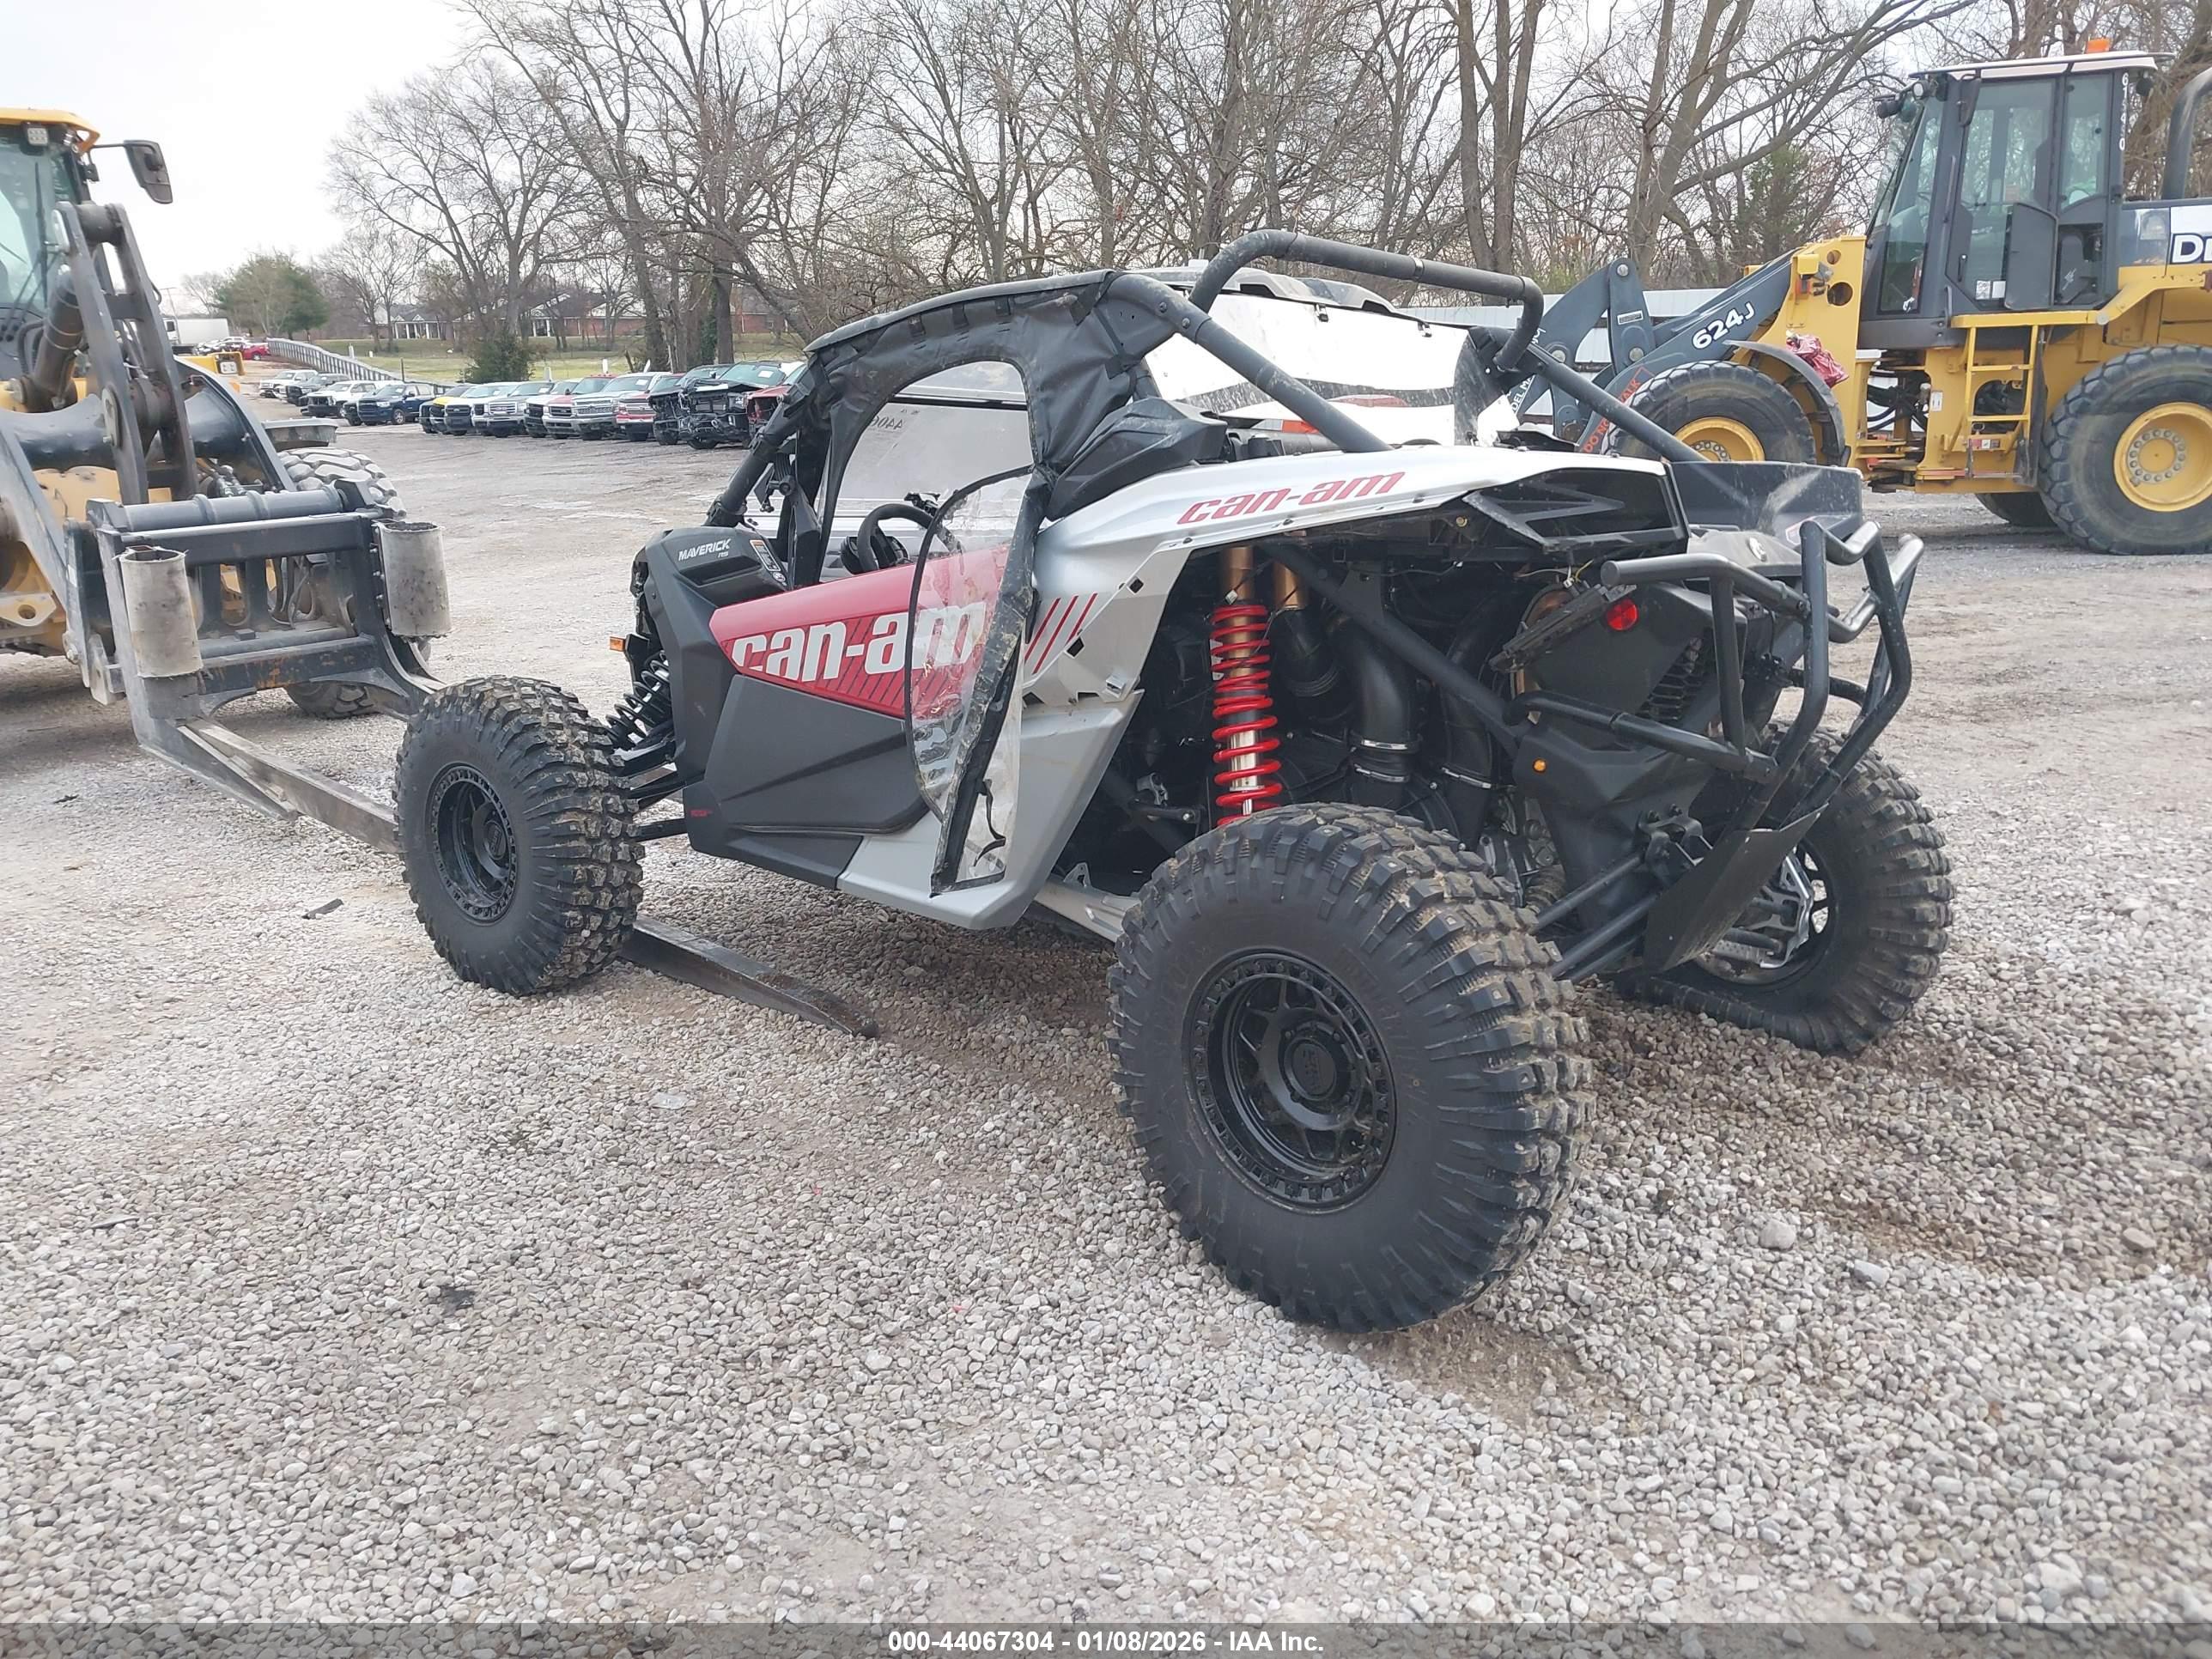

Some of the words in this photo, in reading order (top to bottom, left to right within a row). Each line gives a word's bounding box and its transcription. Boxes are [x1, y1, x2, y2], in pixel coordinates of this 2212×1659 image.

[1692, 302, 1755, 349] 624J
[1583, 435, 1600, 453] DO
[1177, 471, 1406, 525] can-am
[678, 538, 731, 561] MAVERICK
[732, 601, 986, 682] can-am
